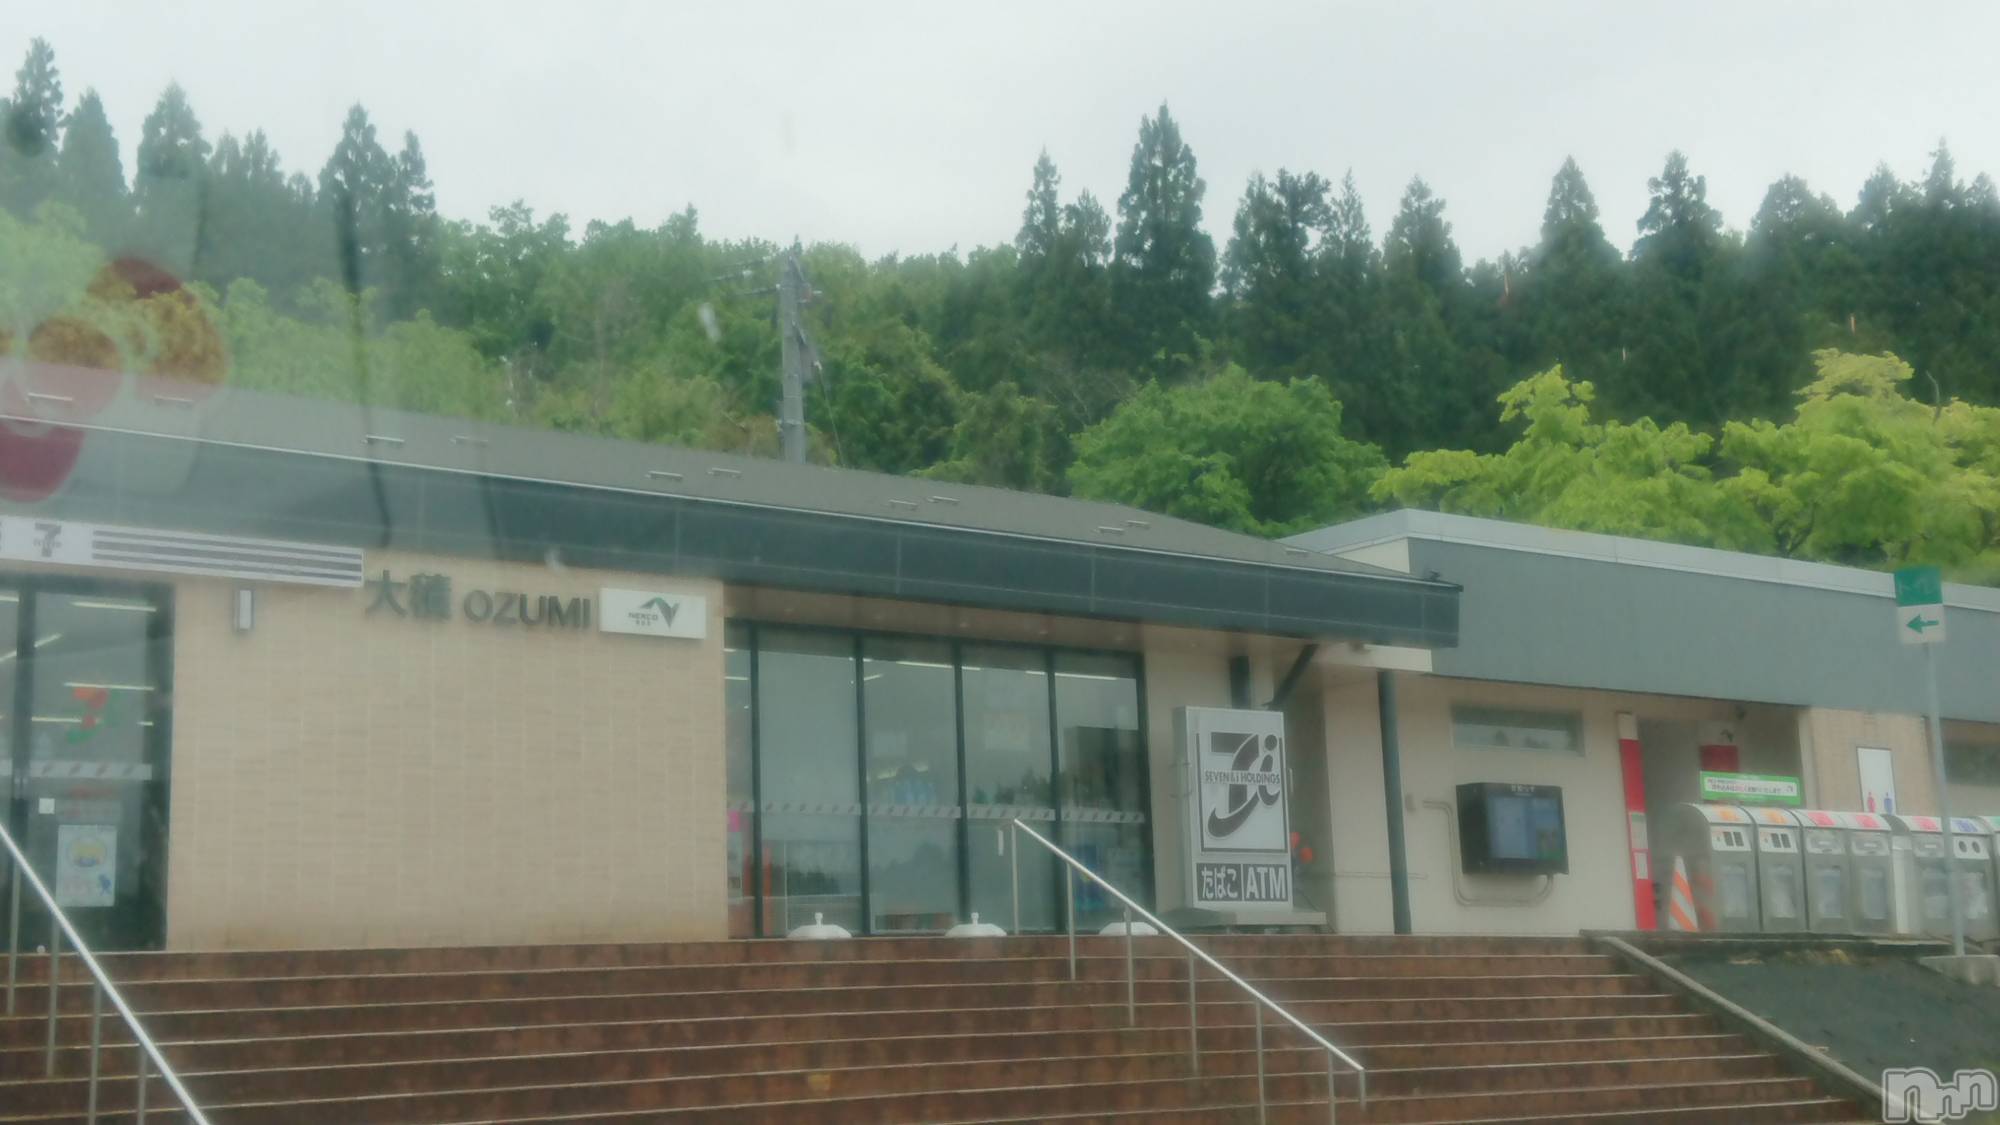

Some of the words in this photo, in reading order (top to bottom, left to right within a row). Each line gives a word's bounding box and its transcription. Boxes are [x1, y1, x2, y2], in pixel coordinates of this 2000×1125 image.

[464, 589, 591, 628] OZUMI
[1241, 772, 1281, 785] HOLDINGS
[1201, 865, 1238, 900] たばこ
[1245, 866, 1286, 900] ATM
